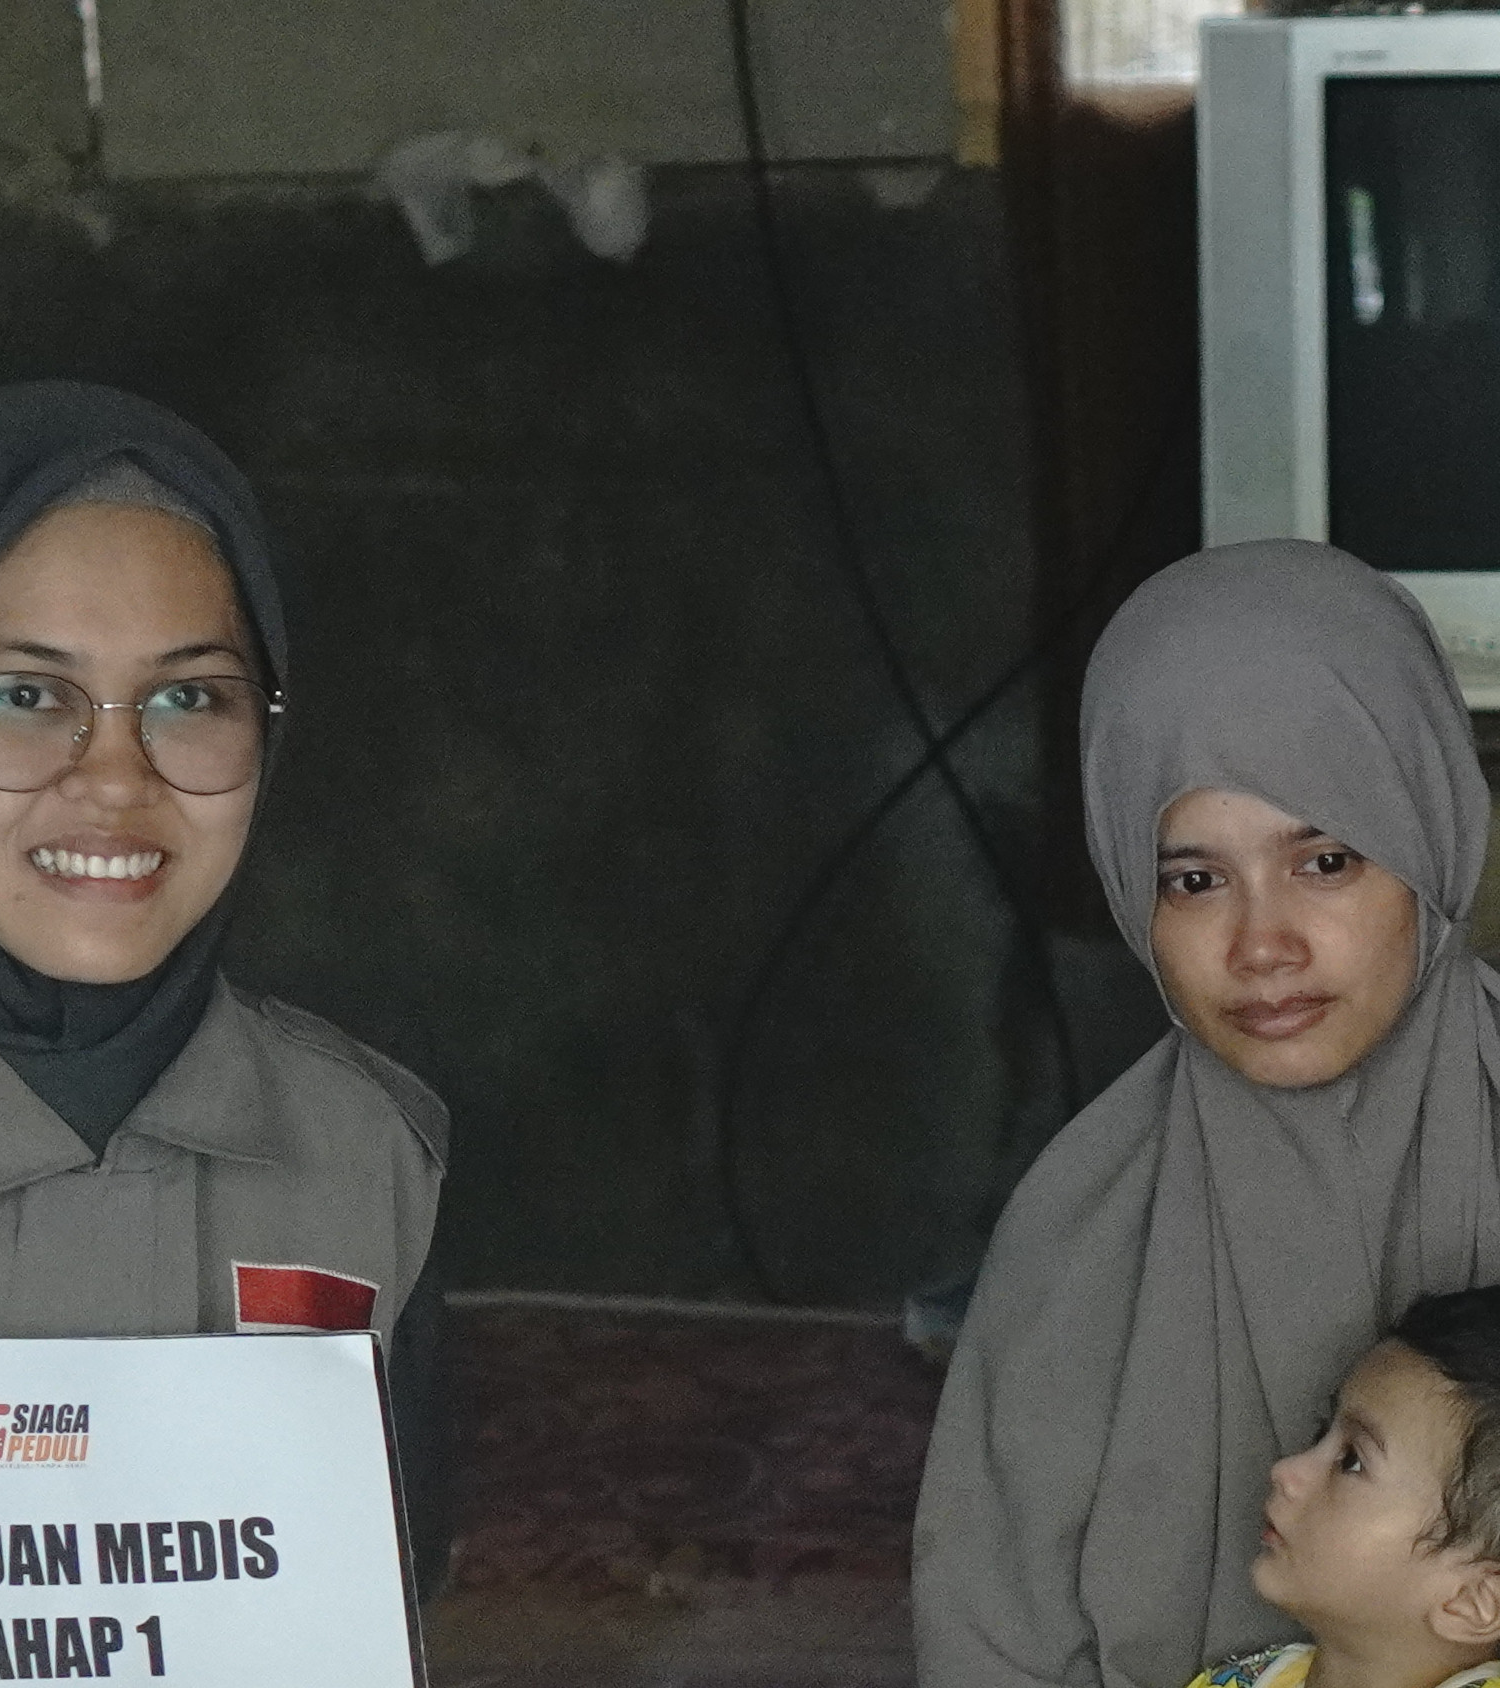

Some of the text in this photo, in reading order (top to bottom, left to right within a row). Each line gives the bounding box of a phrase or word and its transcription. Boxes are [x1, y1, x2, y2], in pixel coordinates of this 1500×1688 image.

[11, 1403, 90, 1434] SIAGA
[6, 1435, 89, 1462] PEDULI
[94, 1516, 279, 1586] MEDIS
[136, 1615, 166, 1677] 1
